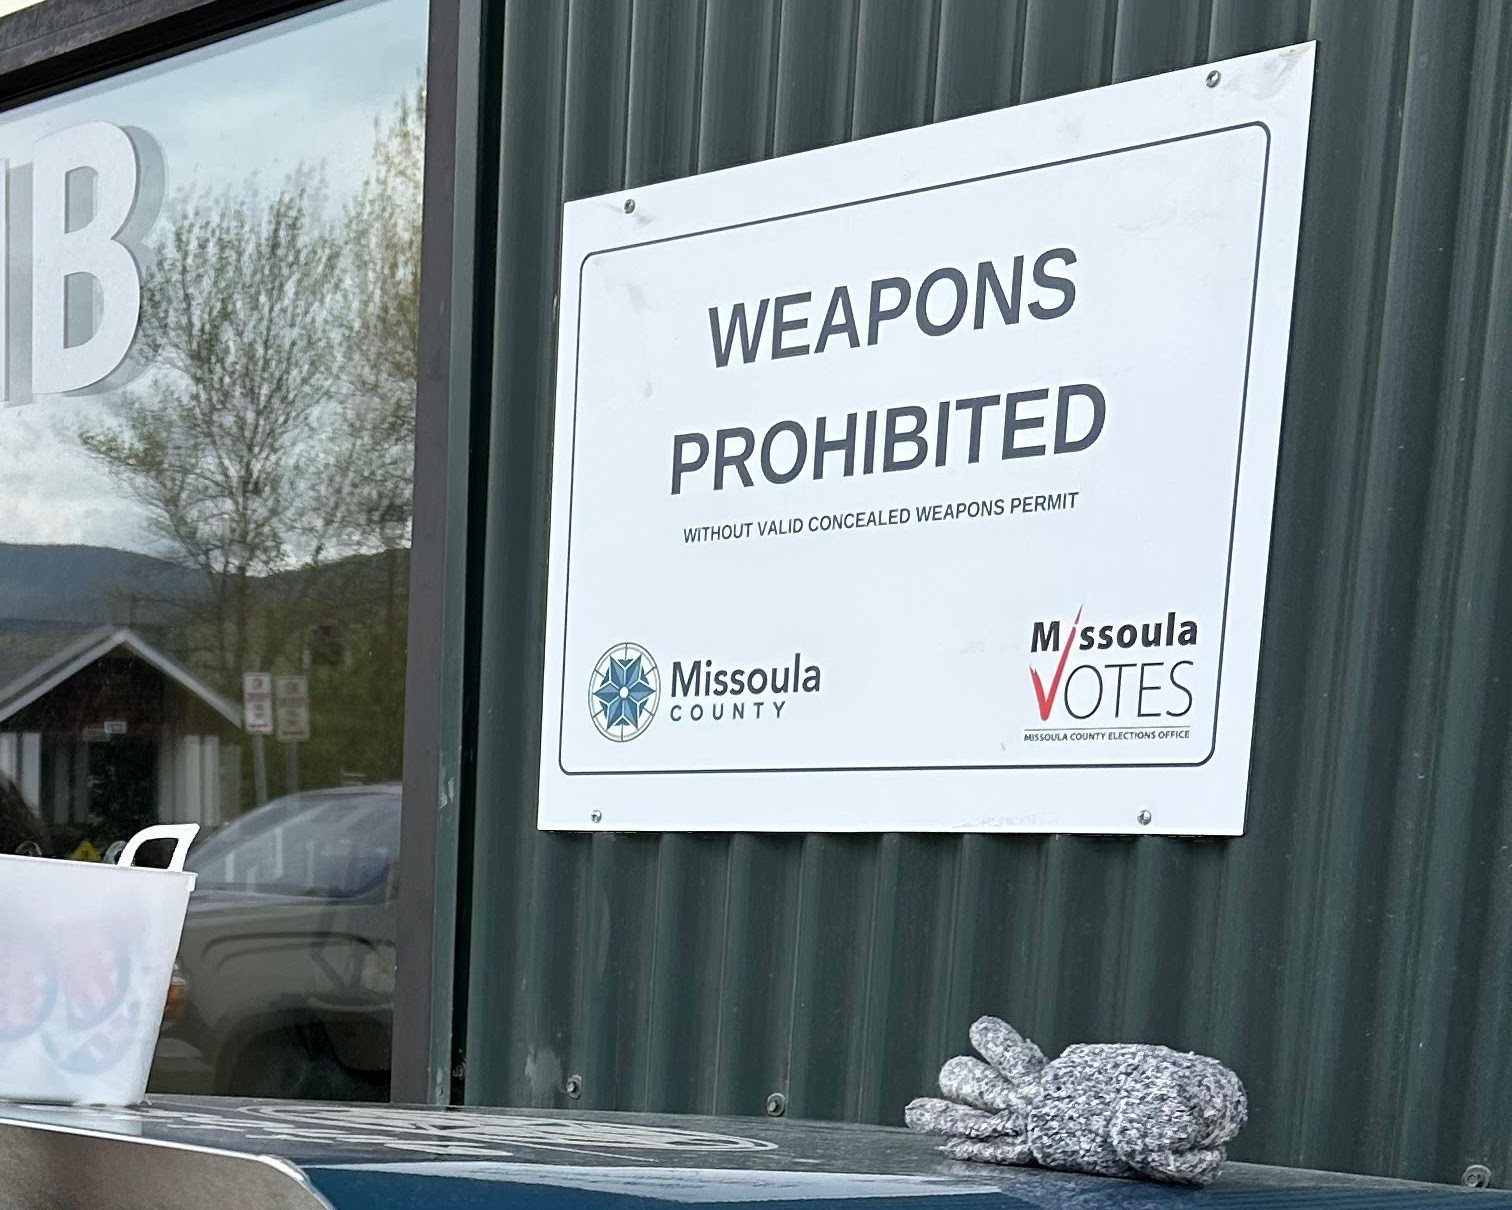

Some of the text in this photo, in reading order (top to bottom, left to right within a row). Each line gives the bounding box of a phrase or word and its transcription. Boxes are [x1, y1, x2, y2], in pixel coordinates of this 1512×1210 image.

[708, 247, 1077, 368] WEAPONS
[670, 383, 1107, 496] PROHIBITED
[683, 491, 1080, 544] WITHOUT VALID CONCEALED WEAPONS PERMIT
[670, 652, 821, 698] Missoula
[670, 701, 786, 722] COUNTY
[1024, 730, 1190, 742] MISSOULA COUNTY ELECTIONS OFFICE
